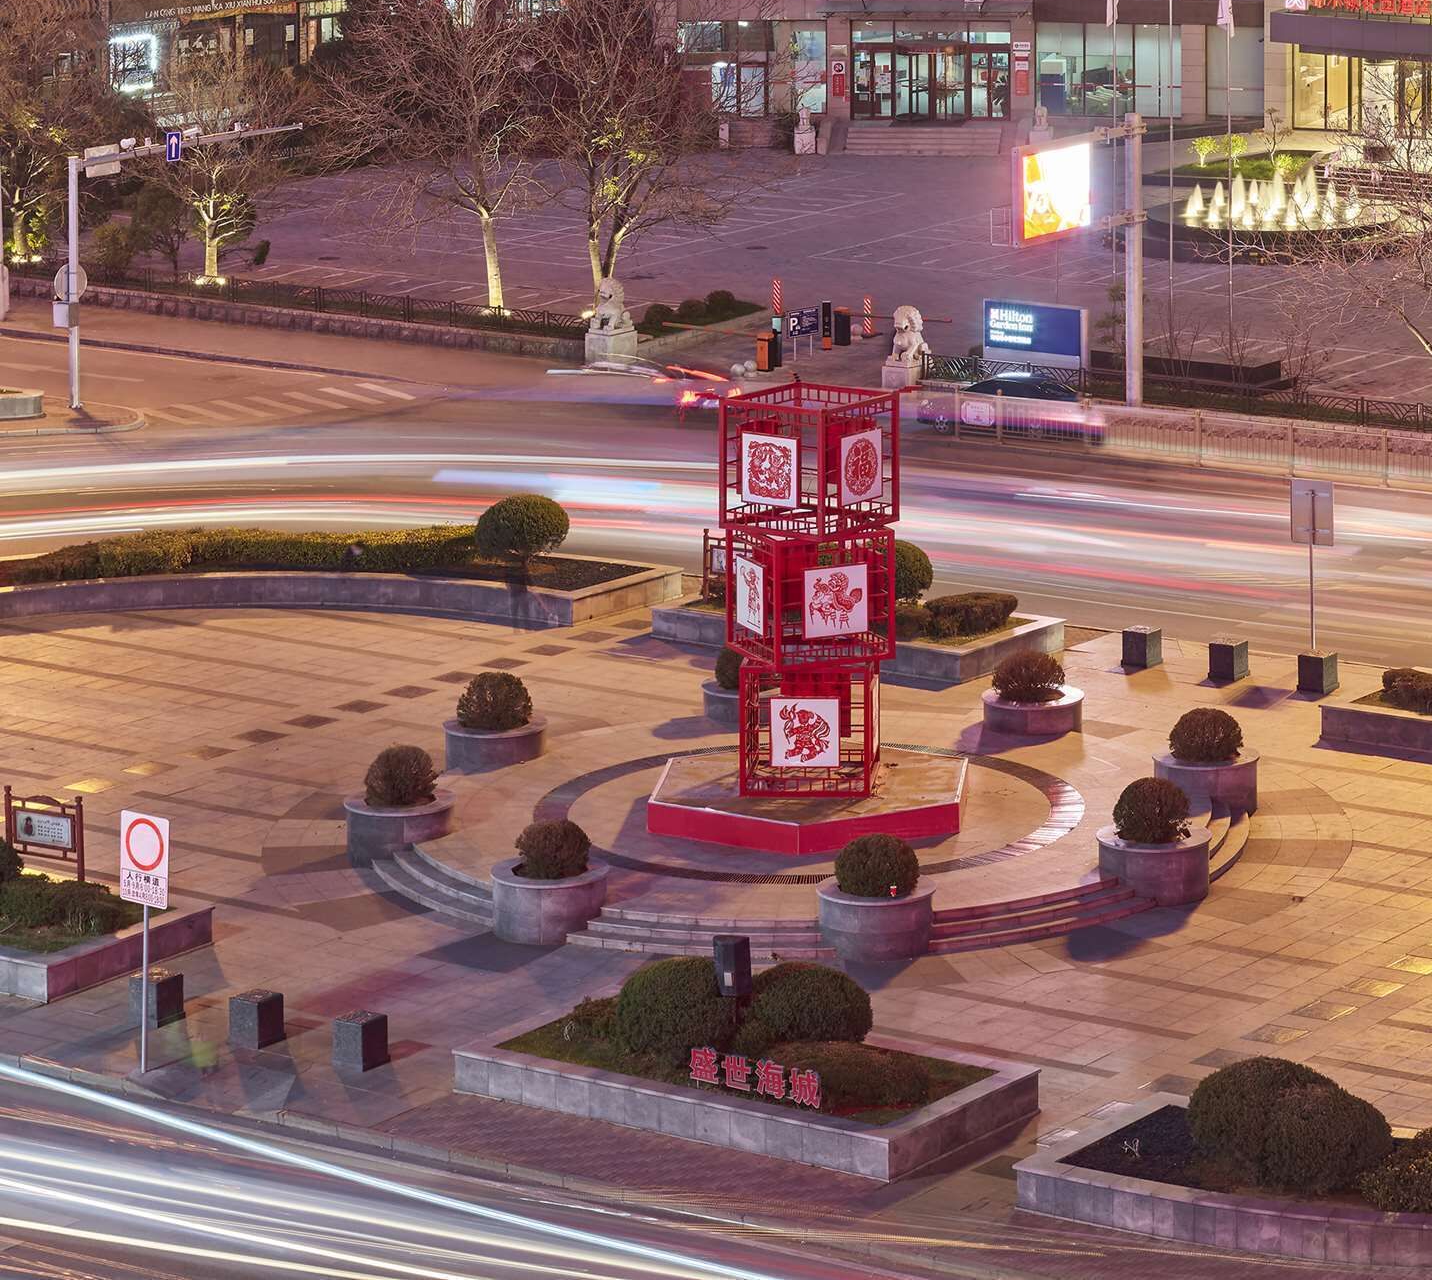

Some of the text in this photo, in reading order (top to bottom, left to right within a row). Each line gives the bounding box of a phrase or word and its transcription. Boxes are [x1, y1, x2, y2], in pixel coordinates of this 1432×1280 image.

[193, 4, 212, 13] WANG
[225, 1, 236, 9] XIU
[237, 0, 252, 8] XIAN
[1000, 309, 1033, 323] Hilton
[790, 317, 798, 331] P
[990, 320, 1033, 332] Garden Inn
[126, 871, 159, 887] 人行横道
[689, 1046, 821, 1109] 盛世海城
